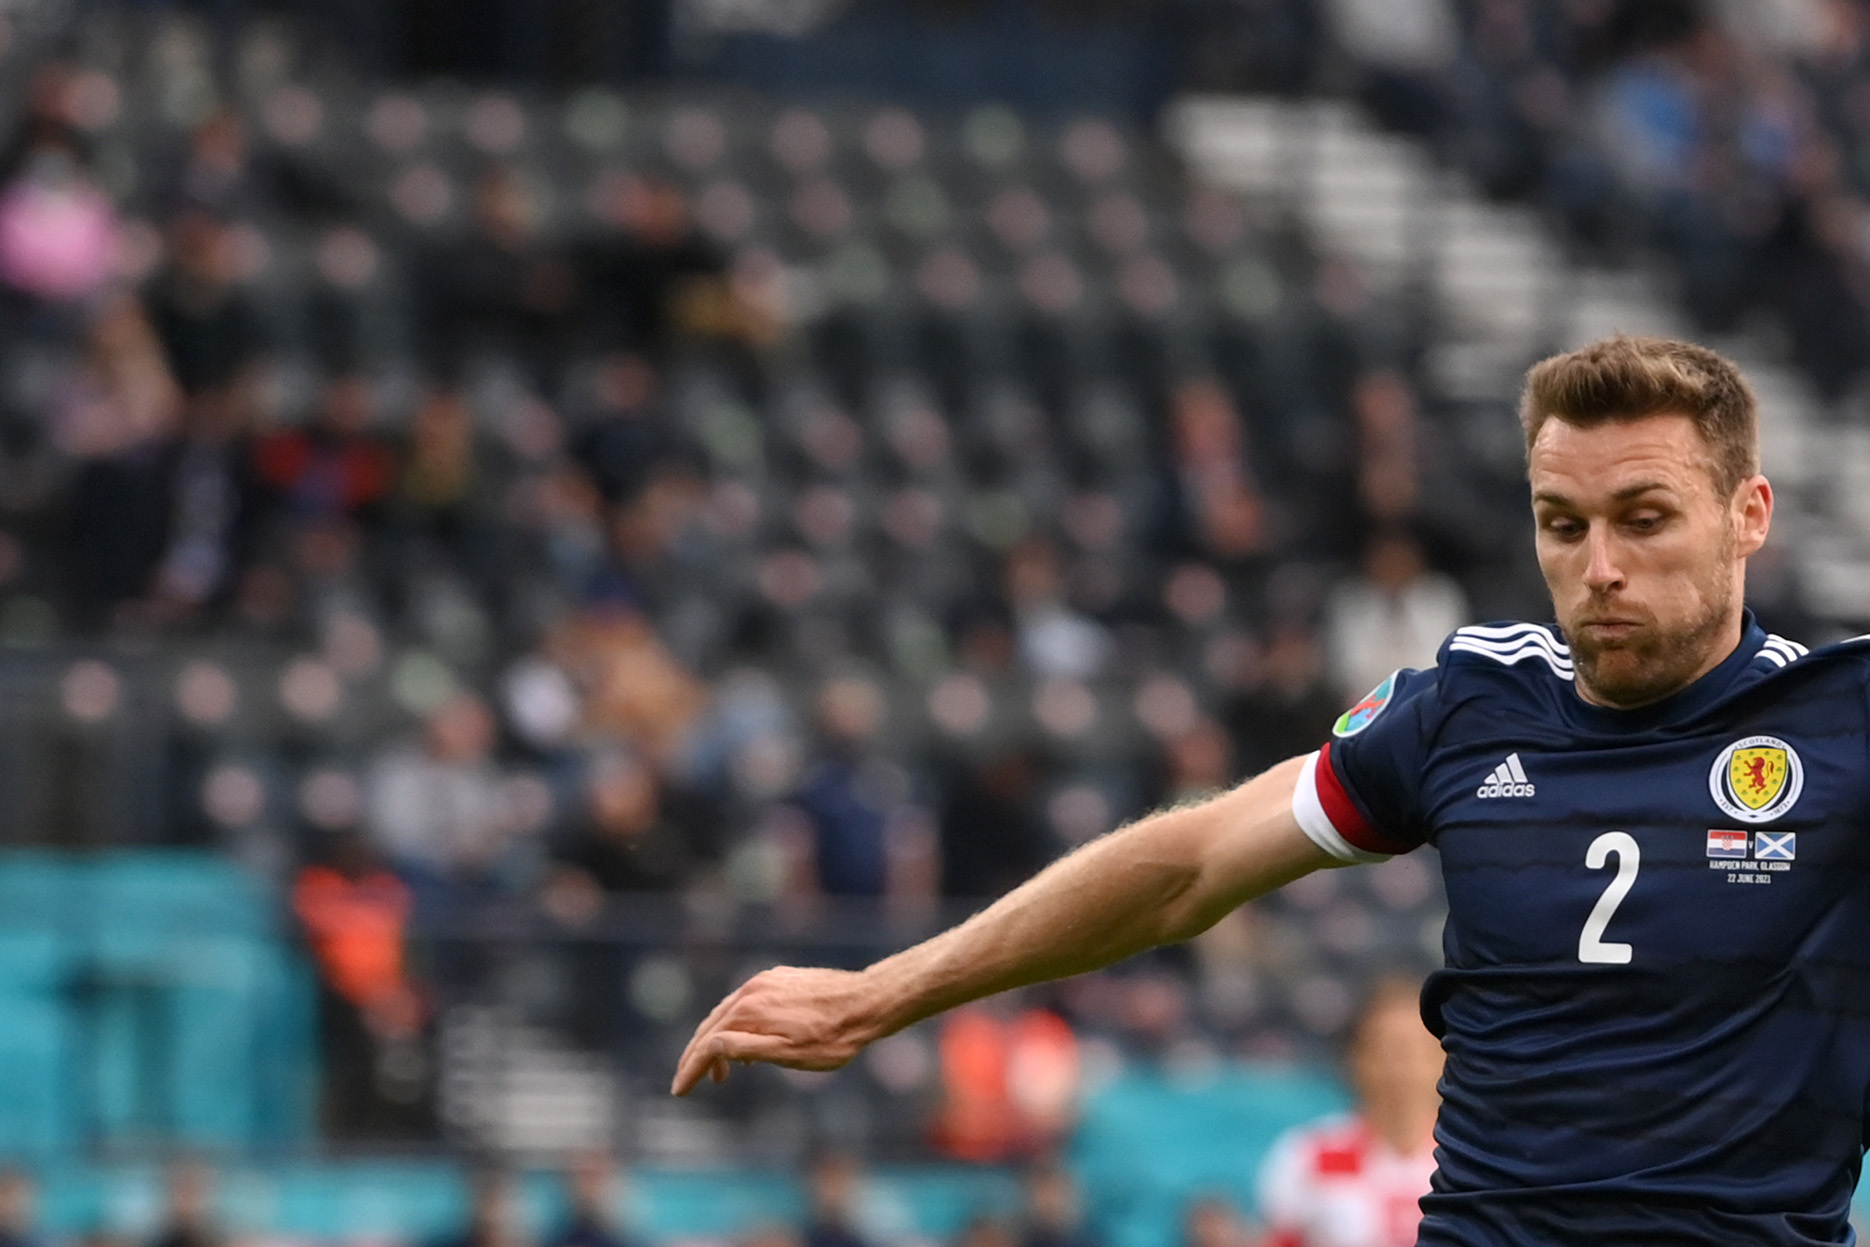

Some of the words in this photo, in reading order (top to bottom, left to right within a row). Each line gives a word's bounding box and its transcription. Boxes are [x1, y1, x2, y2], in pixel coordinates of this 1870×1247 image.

[1738, 737, 1783, 748] SCOTLAND
[1477, 782, 1536, 799] adidas
[1709, 860, 1740, 870] HAMPDEN
[1760, 861, 1791, 871] GLASGOW
[1727, 873, 1737, 883] 22
[1737, 873, 1754, 883] JUNE
[1755, 874, 1771, 884] 2021
[1578, 831, 1641, 964] 2
